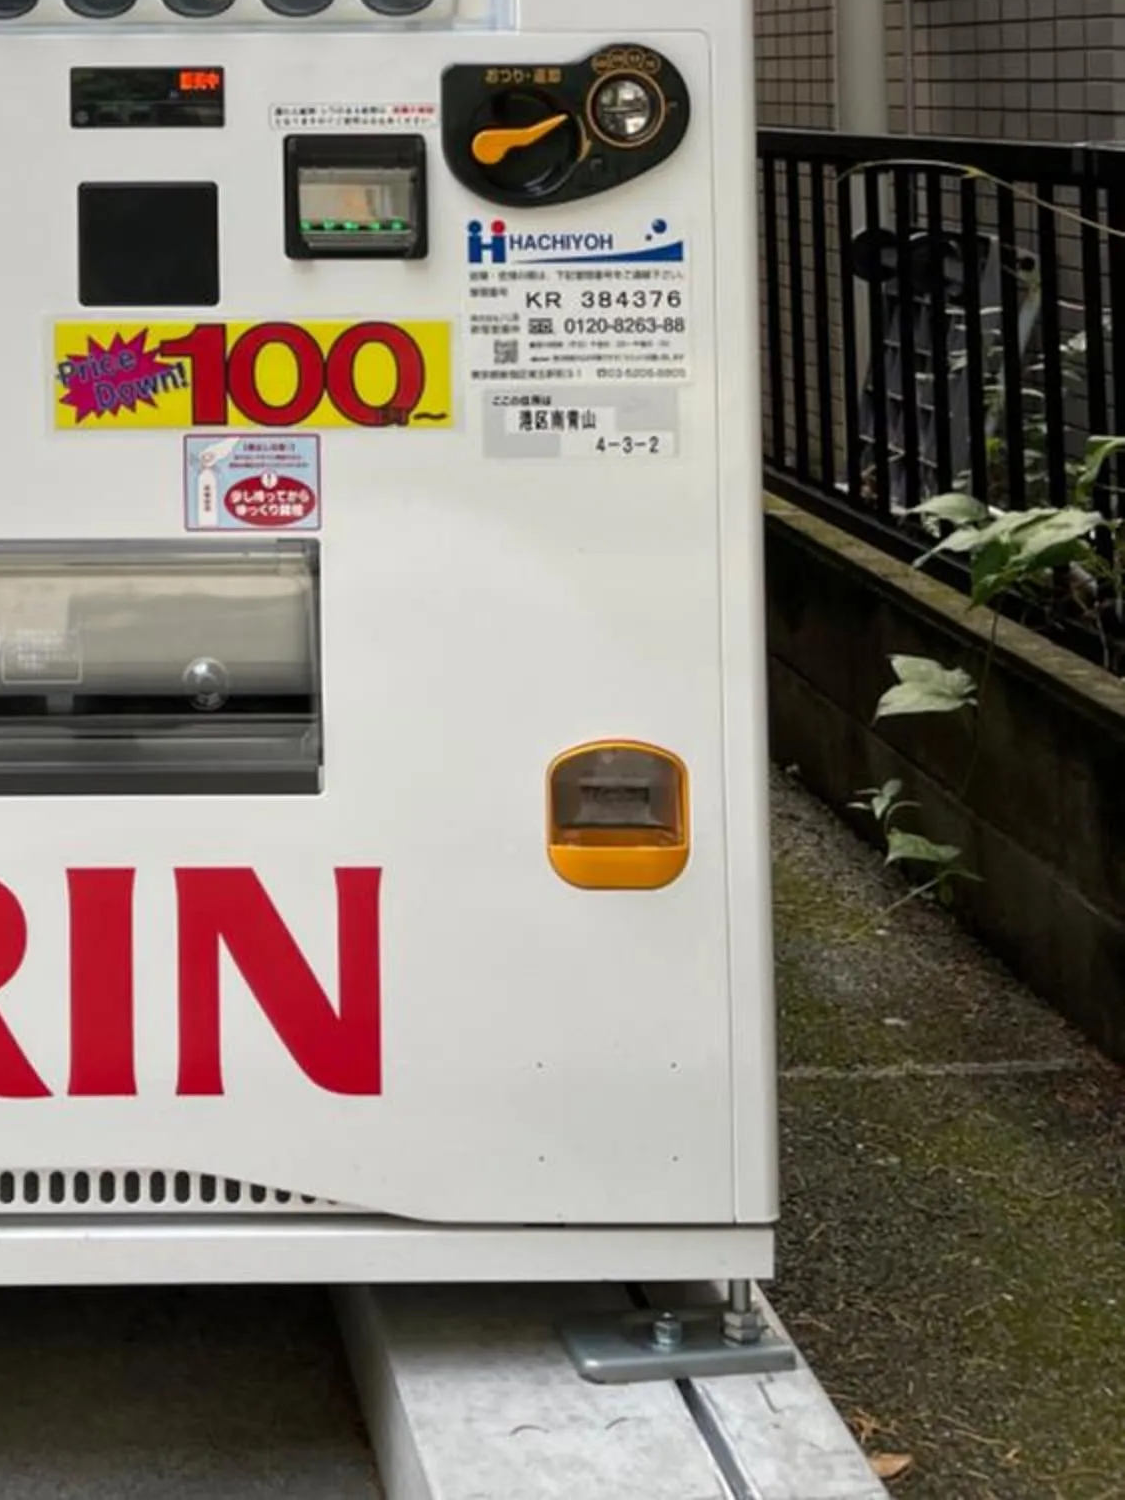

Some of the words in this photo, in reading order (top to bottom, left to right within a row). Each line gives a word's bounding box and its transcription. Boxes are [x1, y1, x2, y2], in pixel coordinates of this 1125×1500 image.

[509, 233, 614, 251] HACHIYOH
[526, 291, 562, 309] KR
[580, 290, 682, 309] 384376
[563, 318, 686, 335] 0120-8263-88
[55, 348, 138, 390] Price
[94, 364, 191, 410] Down!
[518, 409, 597, 431] 港区南青山
